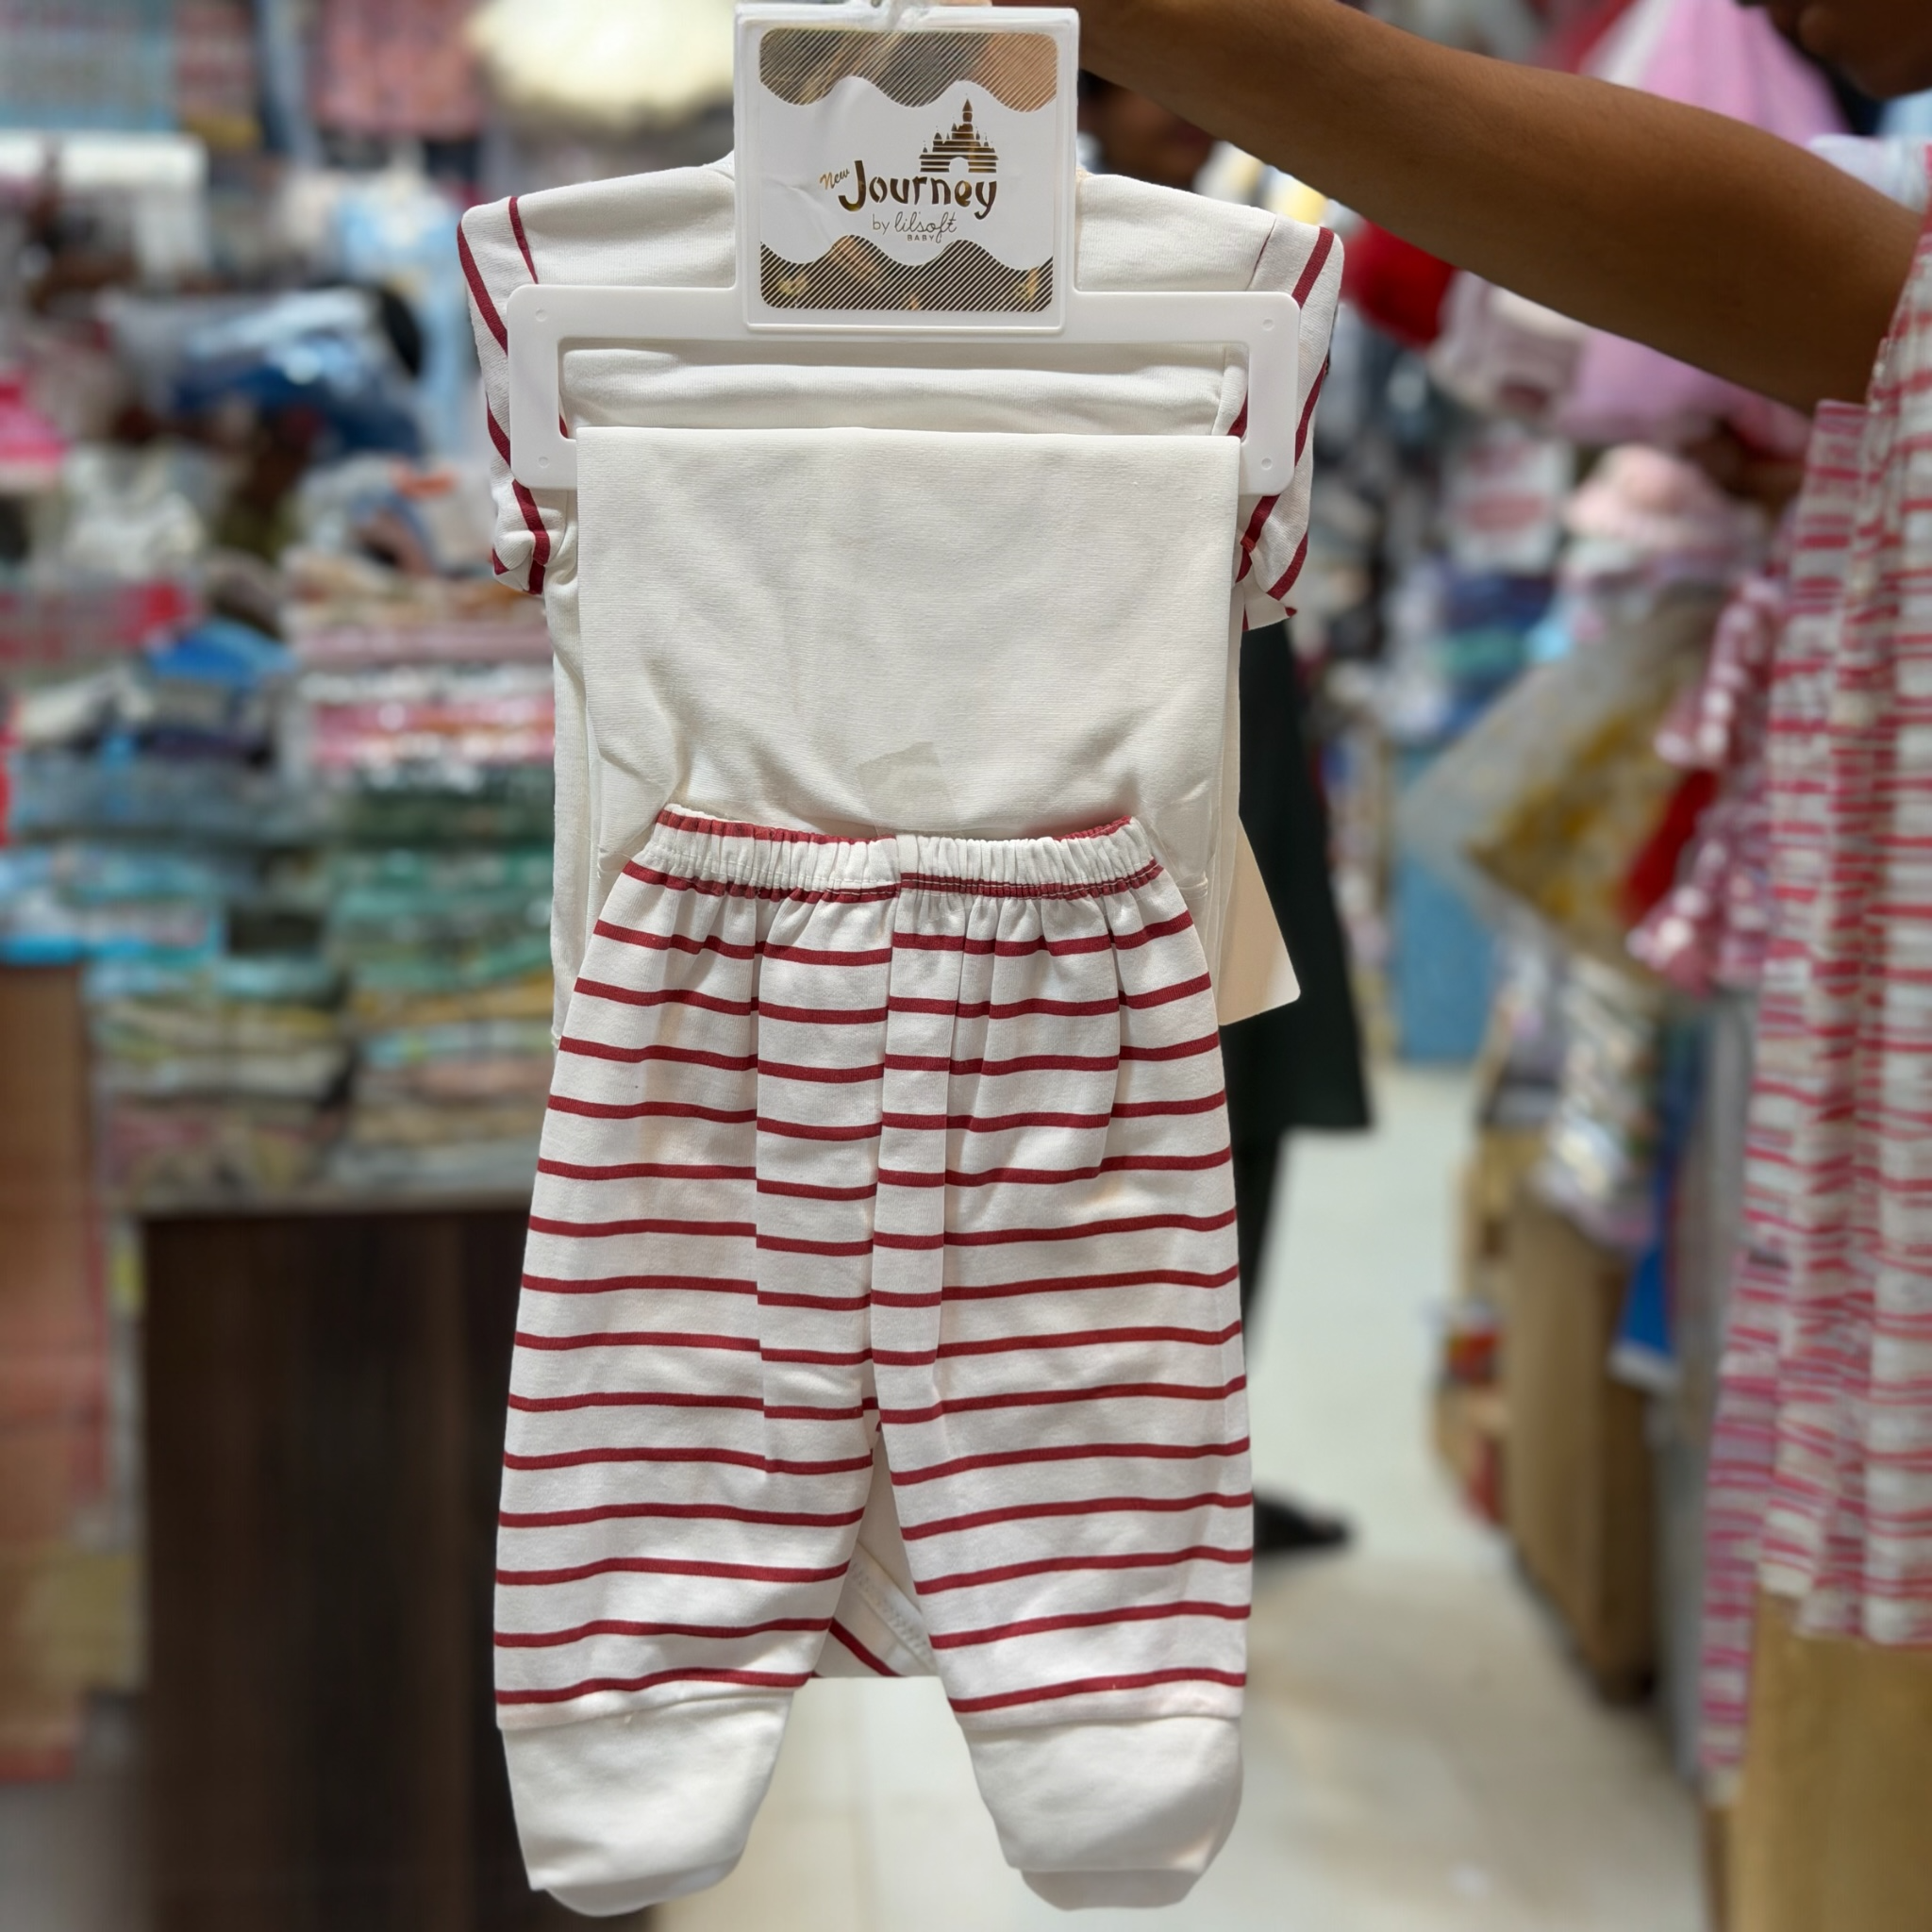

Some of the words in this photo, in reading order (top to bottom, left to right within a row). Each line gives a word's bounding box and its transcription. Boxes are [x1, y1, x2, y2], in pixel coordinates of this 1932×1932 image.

[820, 169, 850, 190] New
[838, 159, 997, 220] Journey
[873, 213, 890, 235] by
